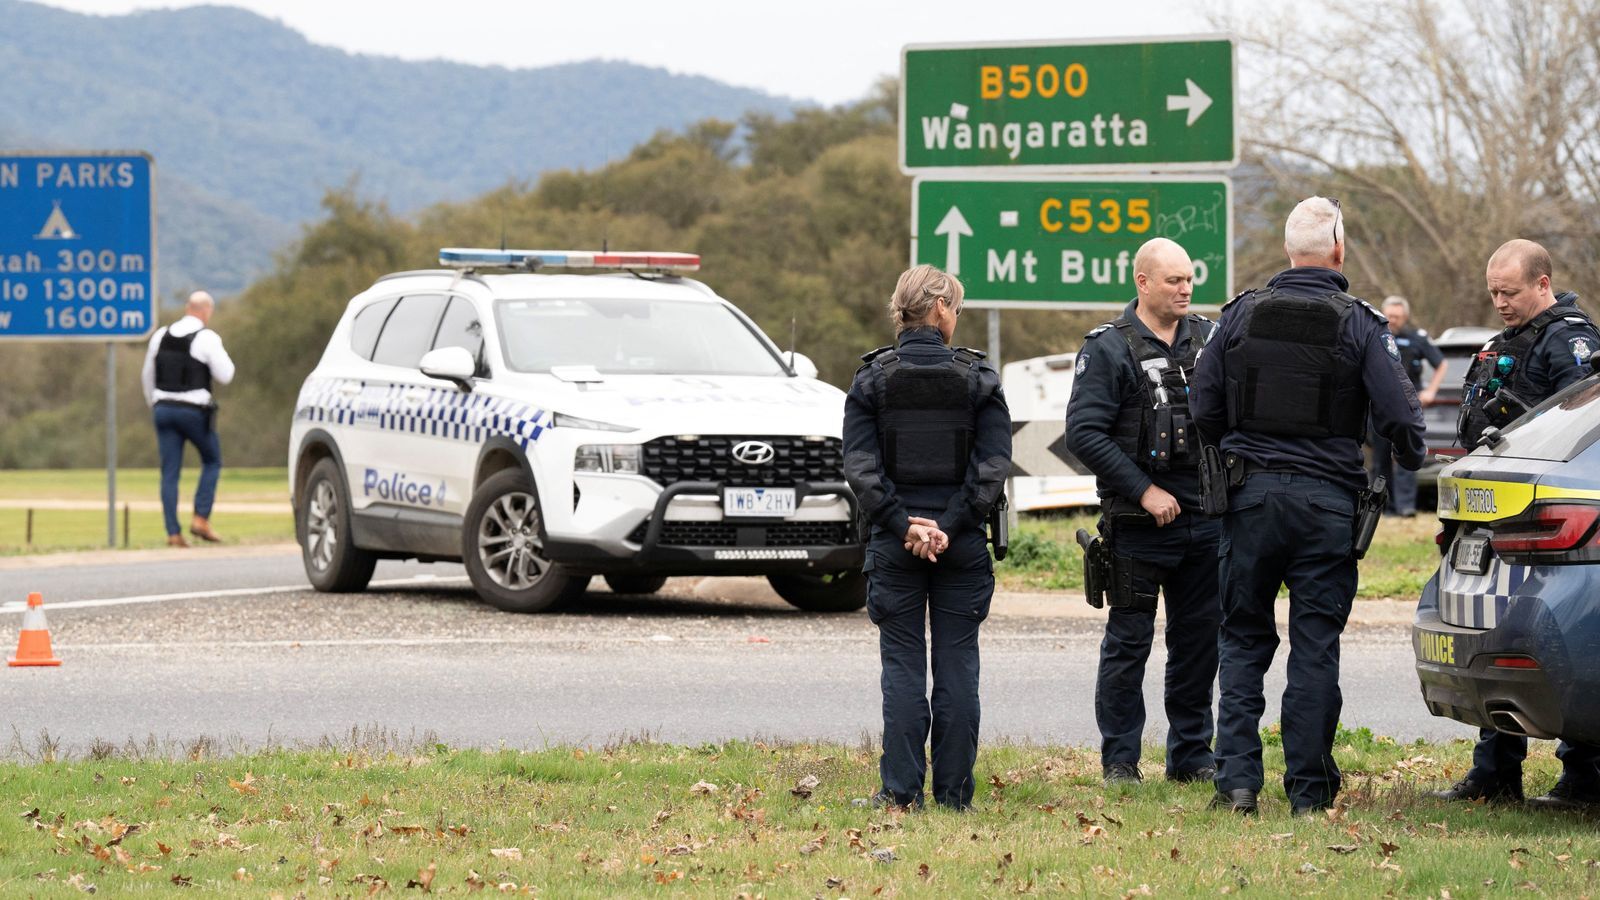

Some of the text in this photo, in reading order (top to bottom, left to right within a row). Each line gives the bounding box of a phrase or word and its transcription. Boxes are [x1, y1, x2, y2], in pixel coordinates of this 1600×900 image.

[980, 63, 1089, 99] B500
[921, 113, 1149, 160] Wangaratta
[36, 162, 135, 188] PARKS
[1039, 198, 1151, 233] C535
[57, 249, 145, 273] 300m
[986, 249, 1038, 283] Mt
[1061, 249, 1209, 286] Bufo
[43, 277, 145, 301] 1300m
[44, 305, 145, 329] 1600m
[363, 467, 432, 506] Police
[1464, 487, 1498, 513] PATROL
[1420, 631, 1455, 664] POLICE
